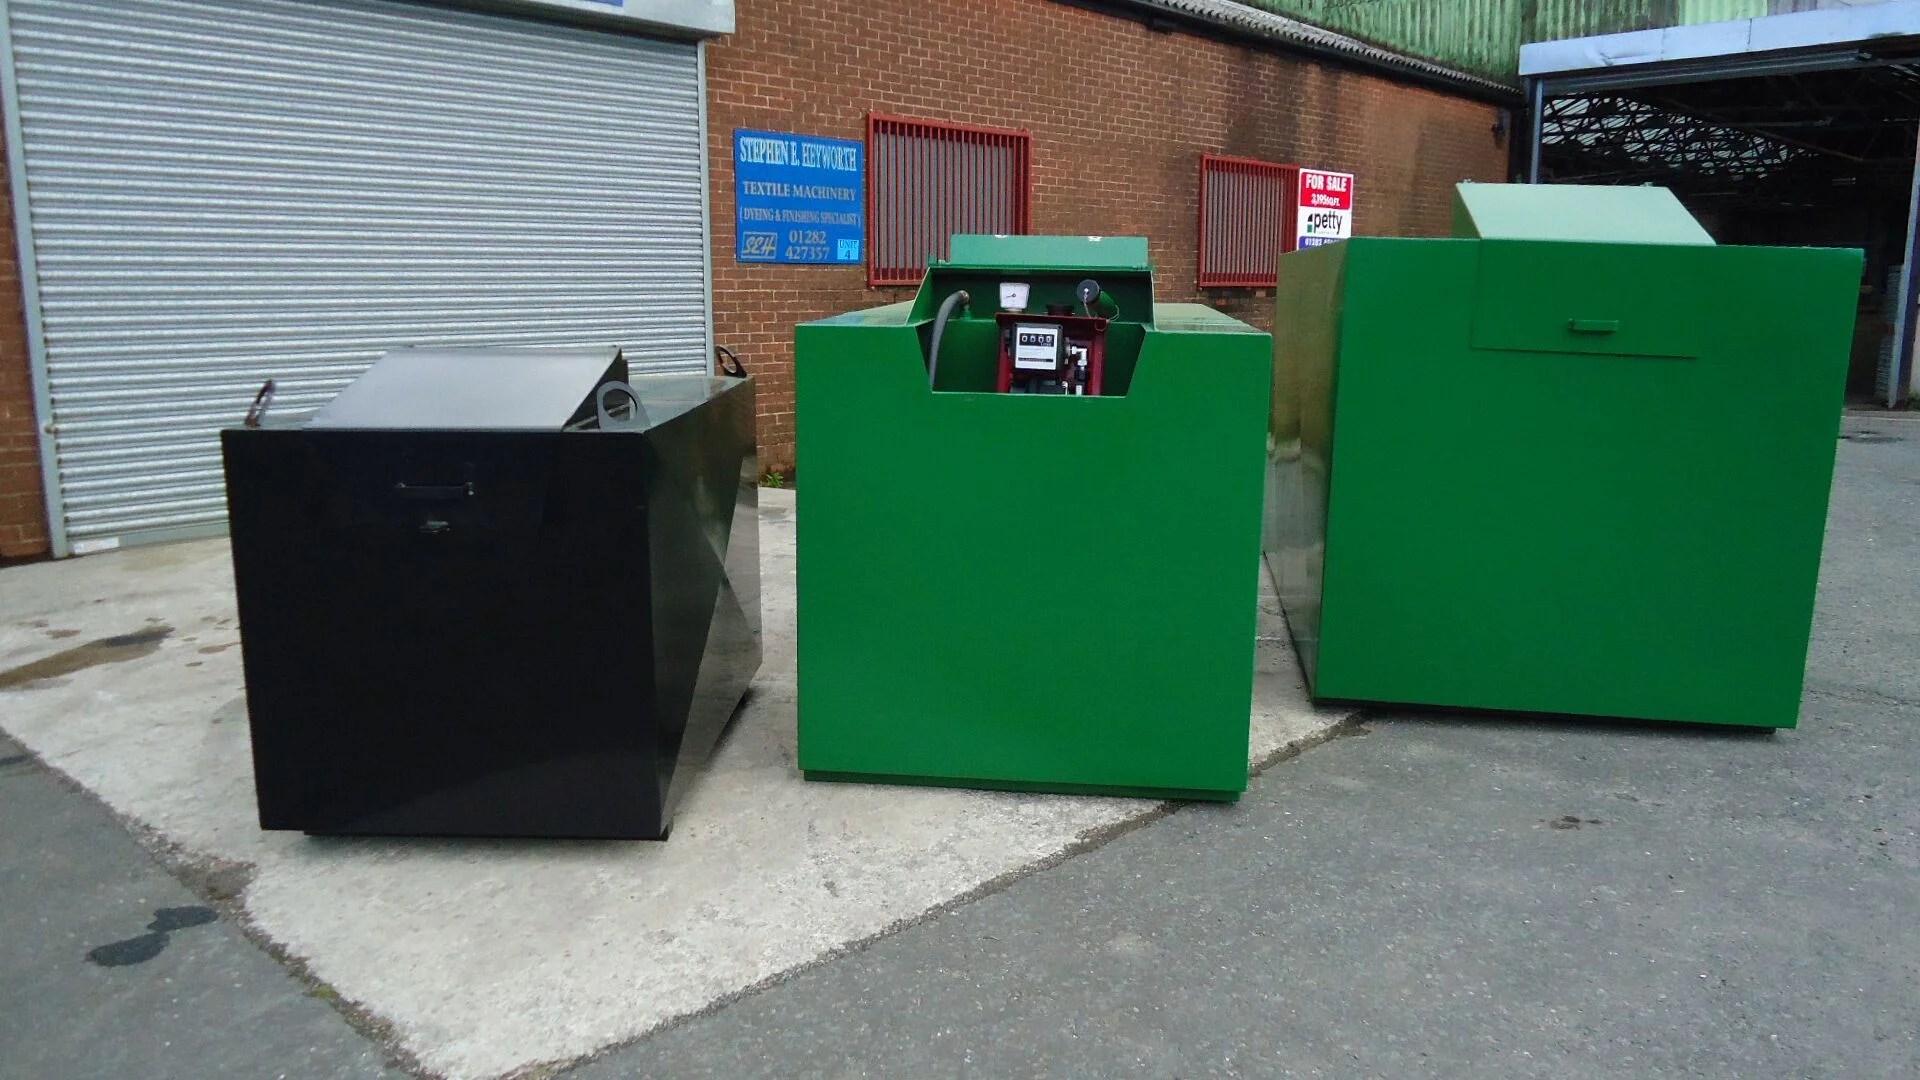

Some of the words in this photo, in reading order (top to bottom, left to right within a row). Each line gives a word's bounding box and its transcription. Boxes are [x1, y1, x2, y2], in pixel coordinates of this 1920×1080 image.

[740, 136, 789, 166] STEPHEN
[802, 142, 857, 172] HEYWORTH
[1306, 174, 1324, 190] FOR
[1326, 176, 1347, 192] SALE
[743, 181, 791, 197] TEXTILE
[793, 185, 857, 201] MACHINERY
[775, 209, 782, 221] &
[782, 209, 820, 223] FINISHING
[1314, 210, 1343, 235] petty
[789, 230, 826, 245] 01282
[839, 240, 858, 249] UNIT
[785, 245, 830, 260] 427357
[844, 249, 851, 259] 4
